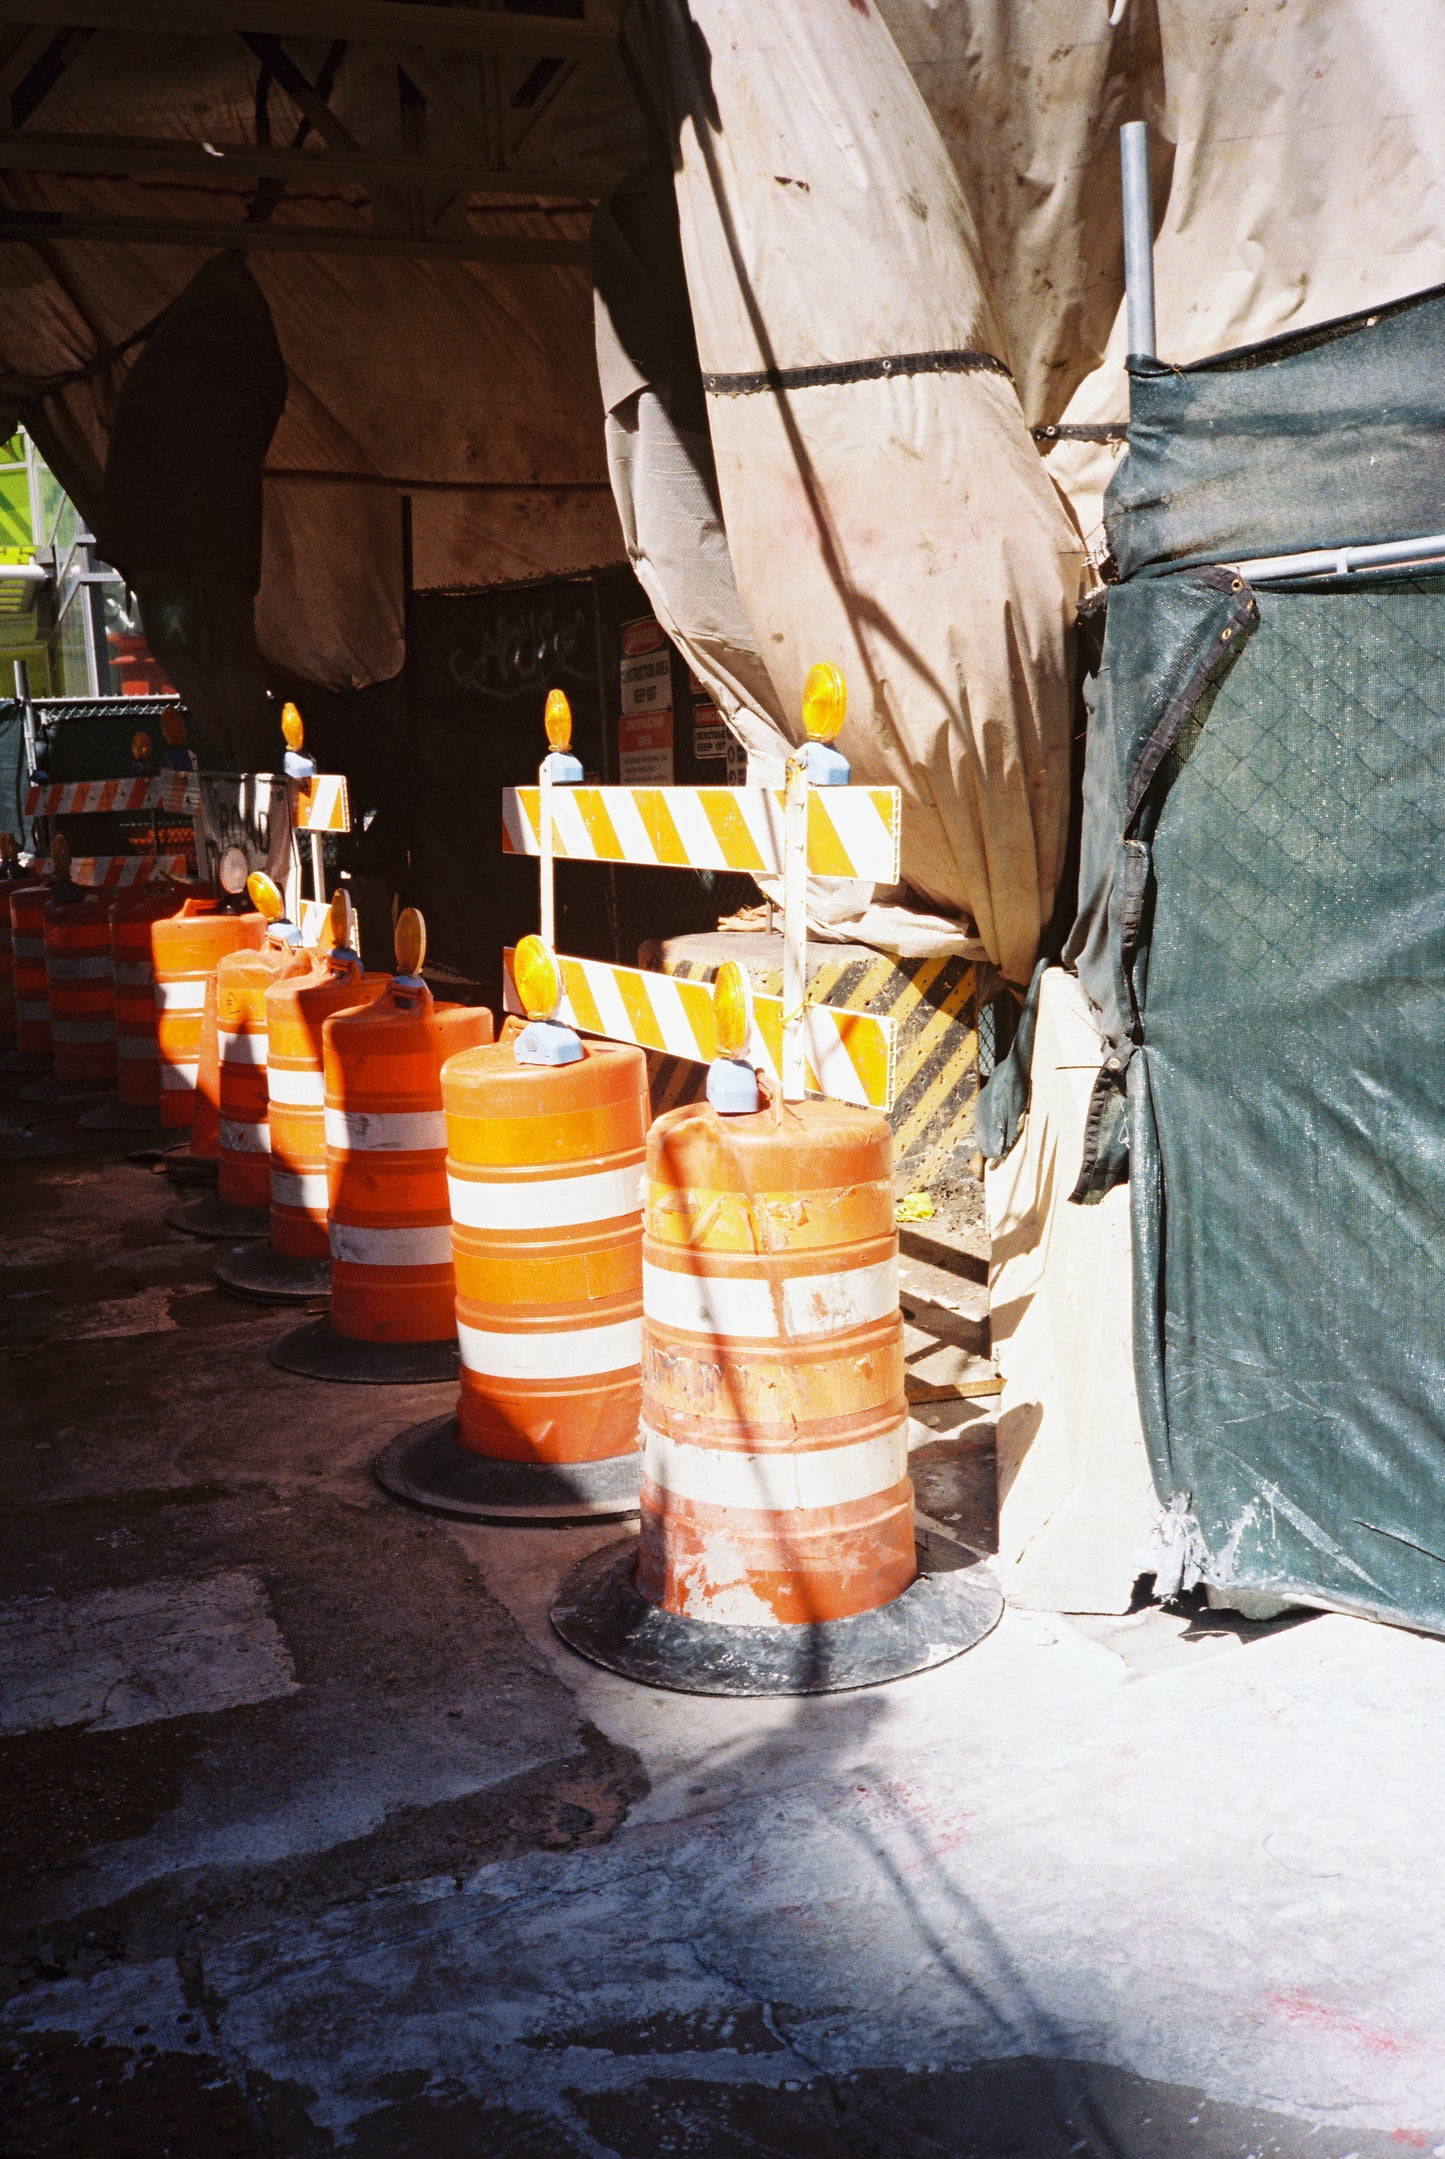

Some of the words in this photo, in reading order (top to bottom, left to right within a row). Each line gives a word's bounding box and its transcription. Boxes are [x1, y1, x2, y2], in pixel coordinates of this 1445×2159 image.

[634, 688, 646, 703] KEEP
[647, 686, 657, 701] OUT
[697, 742, 713, 752] KEEP
